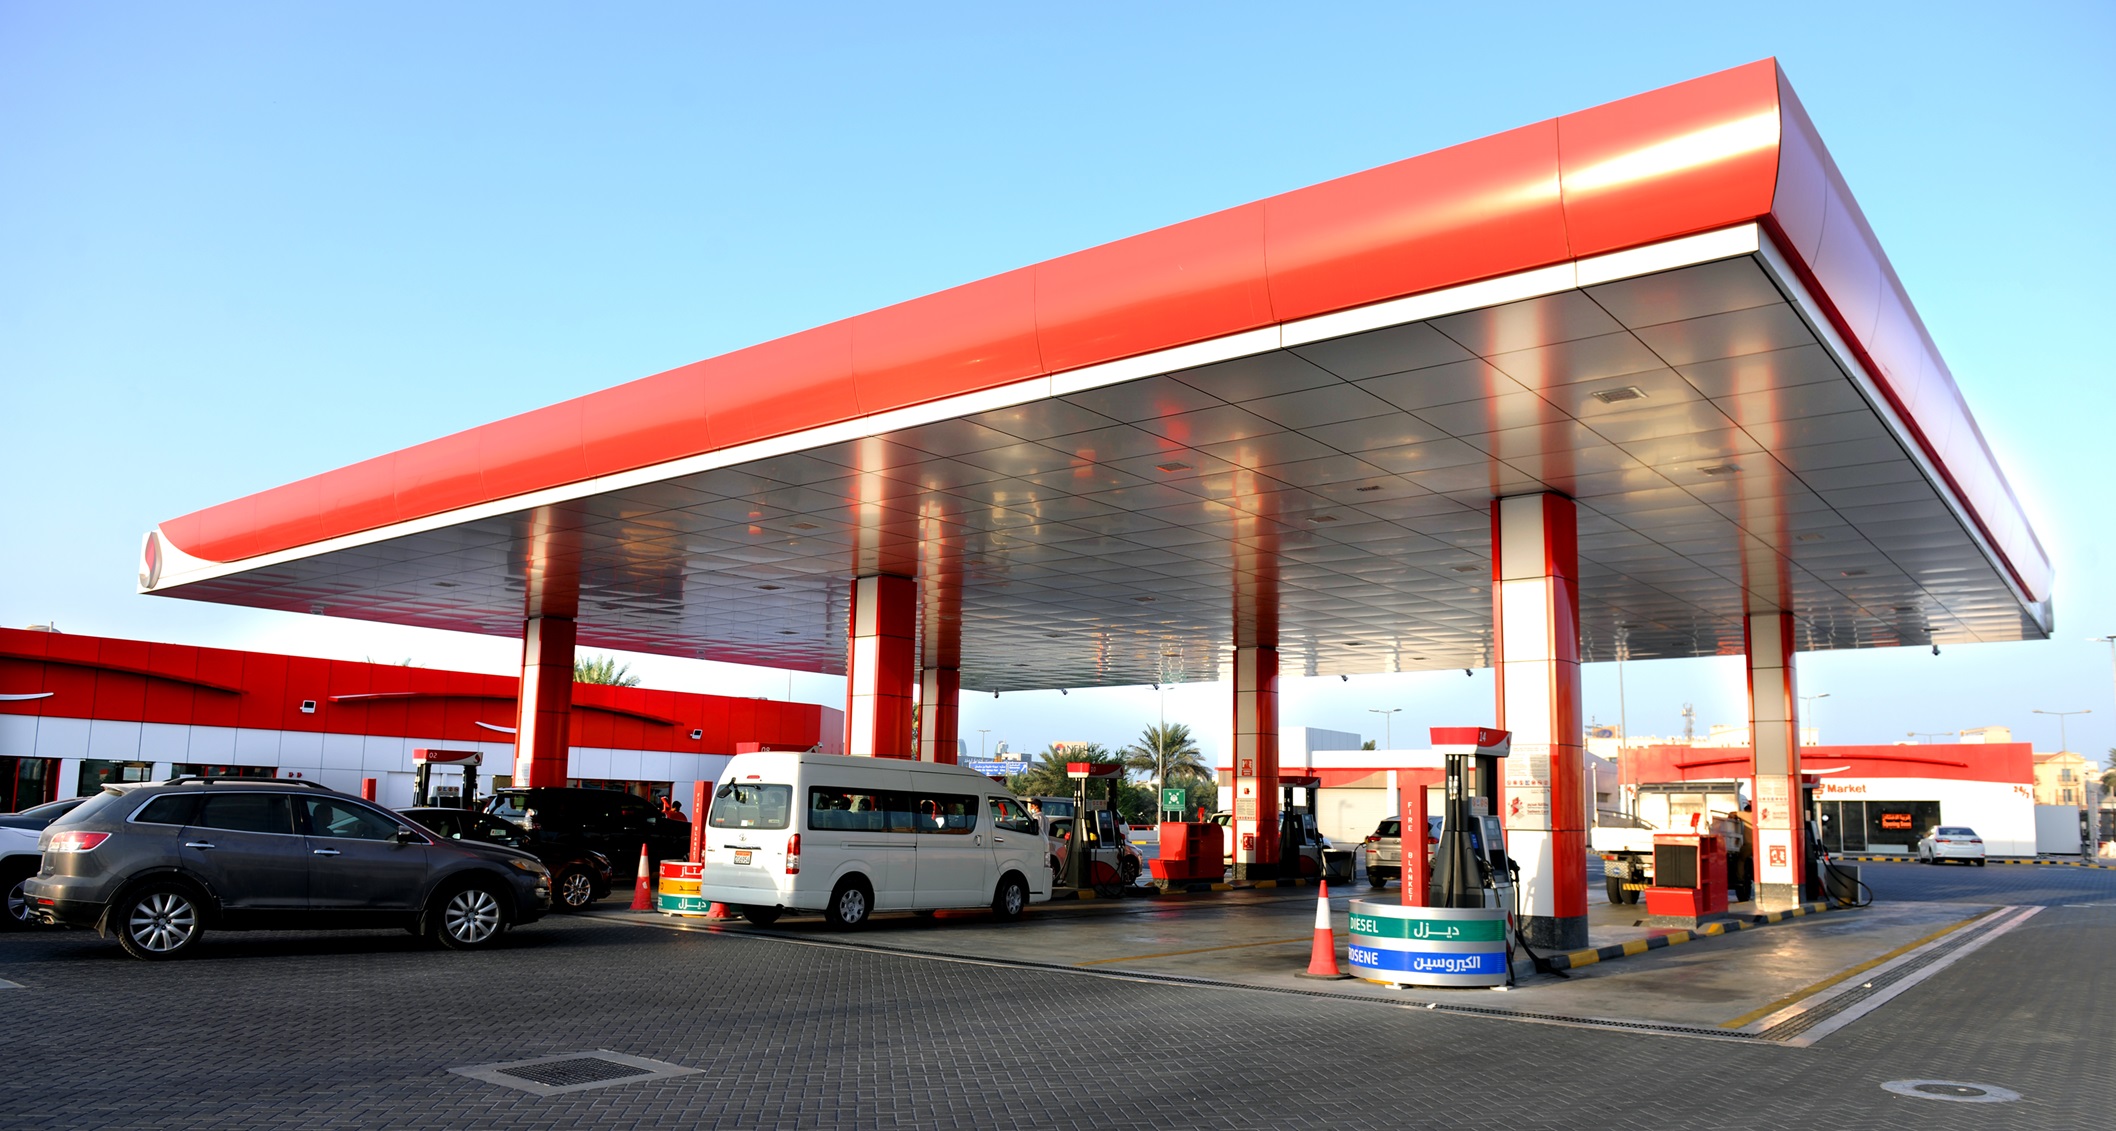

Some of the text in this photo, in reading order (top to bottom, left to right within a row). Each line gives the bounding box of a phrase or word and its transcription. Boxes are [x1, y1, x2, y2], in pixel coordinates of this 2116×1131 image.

[1479, 731, 1487, 742] 14
[1827, 784, 1867, 794] Market
[678, 898, 707, 910] ديزل
[1350, 916, 1379, 933] DIESEL
[1414, 921, 1460, 939] ديزل
[1413, 956, 1481, 972] الكيروسين
